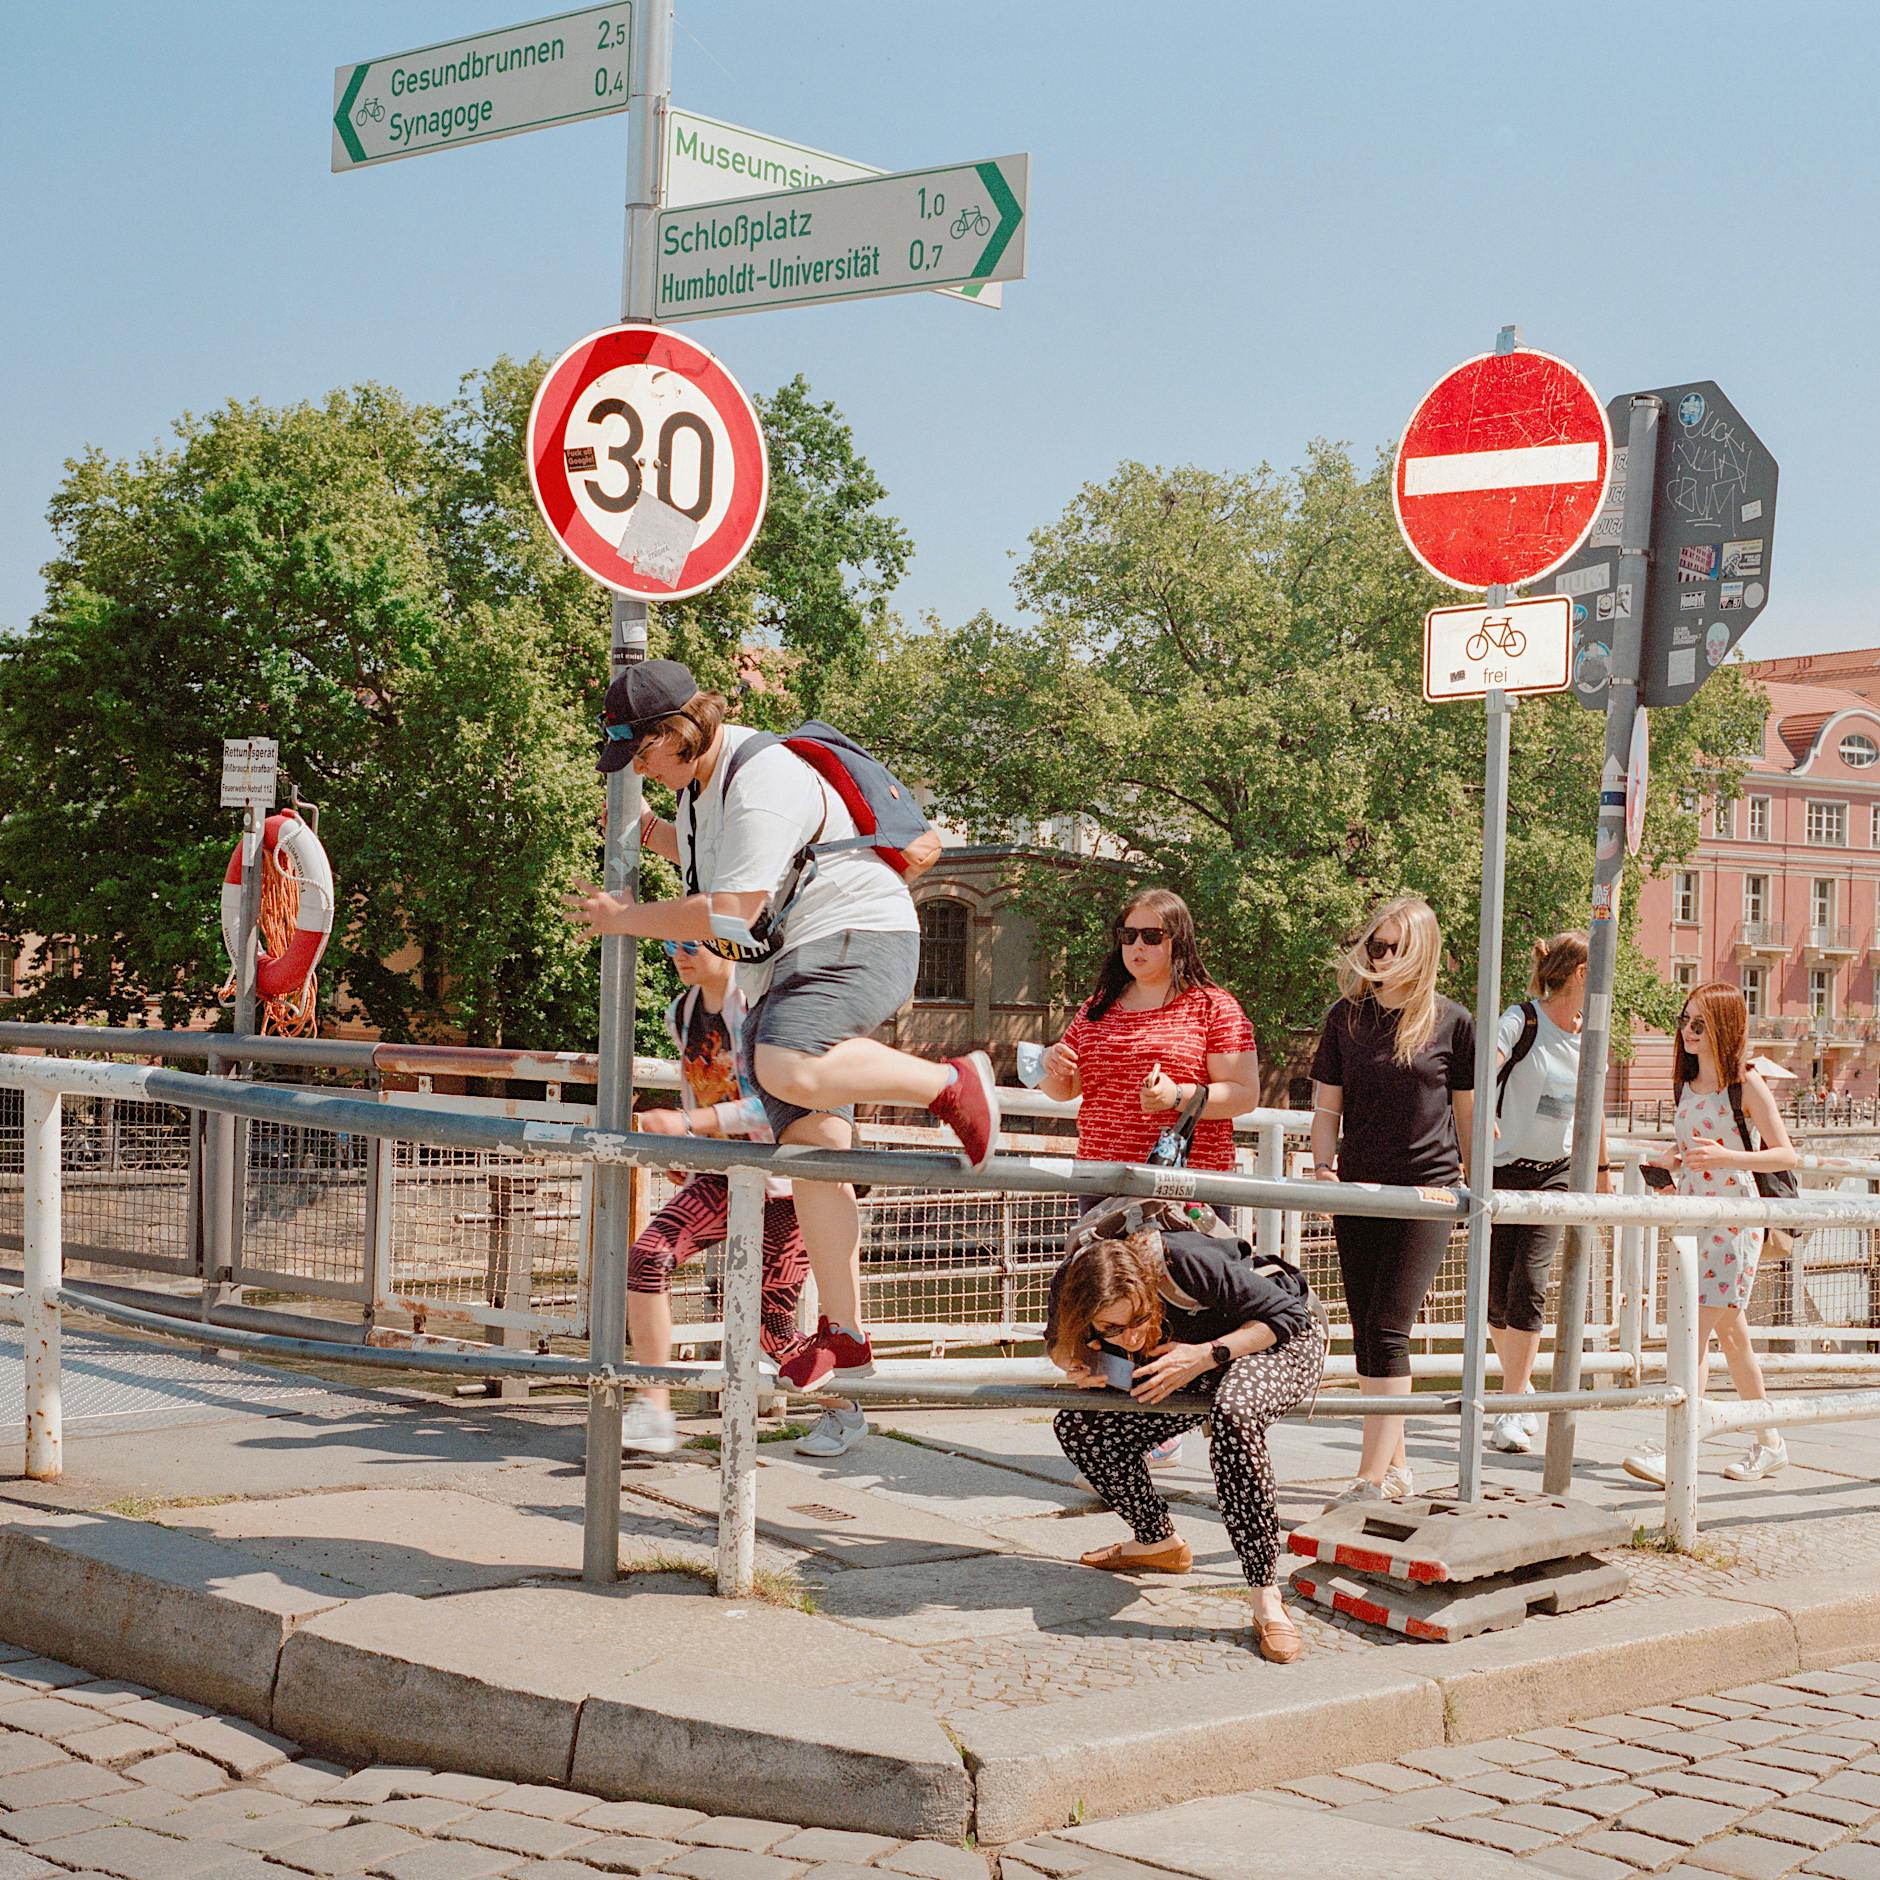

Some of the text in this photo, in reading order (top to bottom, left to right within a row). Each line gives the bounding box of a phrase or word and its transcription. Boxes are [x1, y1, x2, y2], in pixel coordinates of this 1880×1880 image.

[391, 19, 626, 97] Gesundbrunnen 2,5
[389, 67, 624, 147] Synagoge 0,4
[675, 126, 836, 188] Museumsin
[664, 187, 945, 256] Schloßplatz 1,0
[661, 238, 943, 304] Humboldt-Universität 0,7
[584, 397, 715, 523] 30
[1483, 666, 1508, 684] frei
